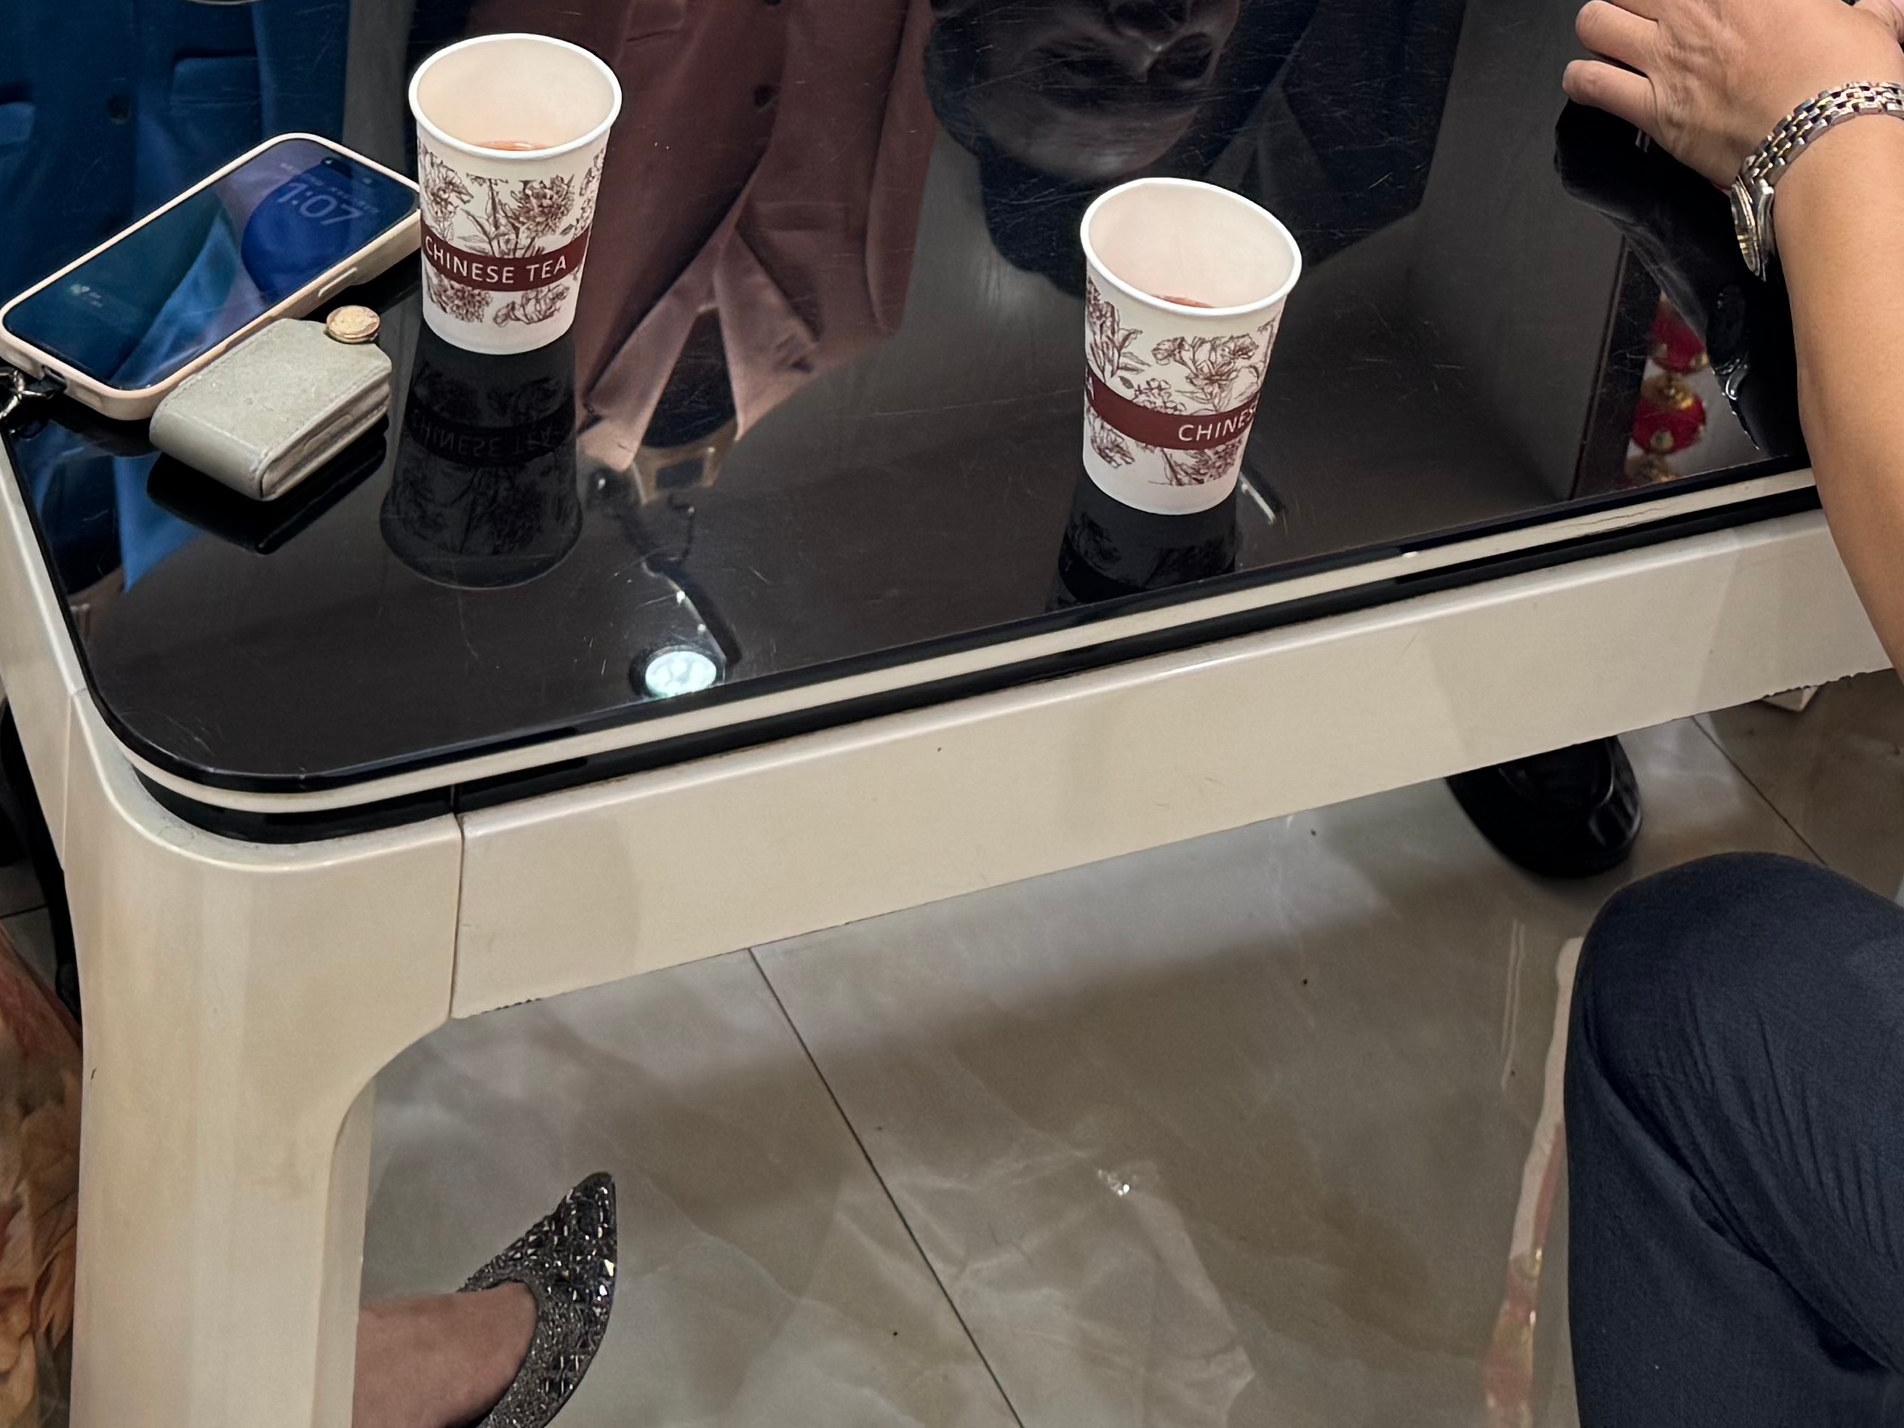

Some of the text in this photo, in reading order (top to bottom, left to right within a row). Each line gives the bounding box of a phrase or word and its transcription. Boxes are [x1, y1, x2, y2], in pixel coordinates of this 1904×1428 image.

[425, 235, 567, 284] CHINESE TEA
[1178, 402, 1257, 442] CHINES
